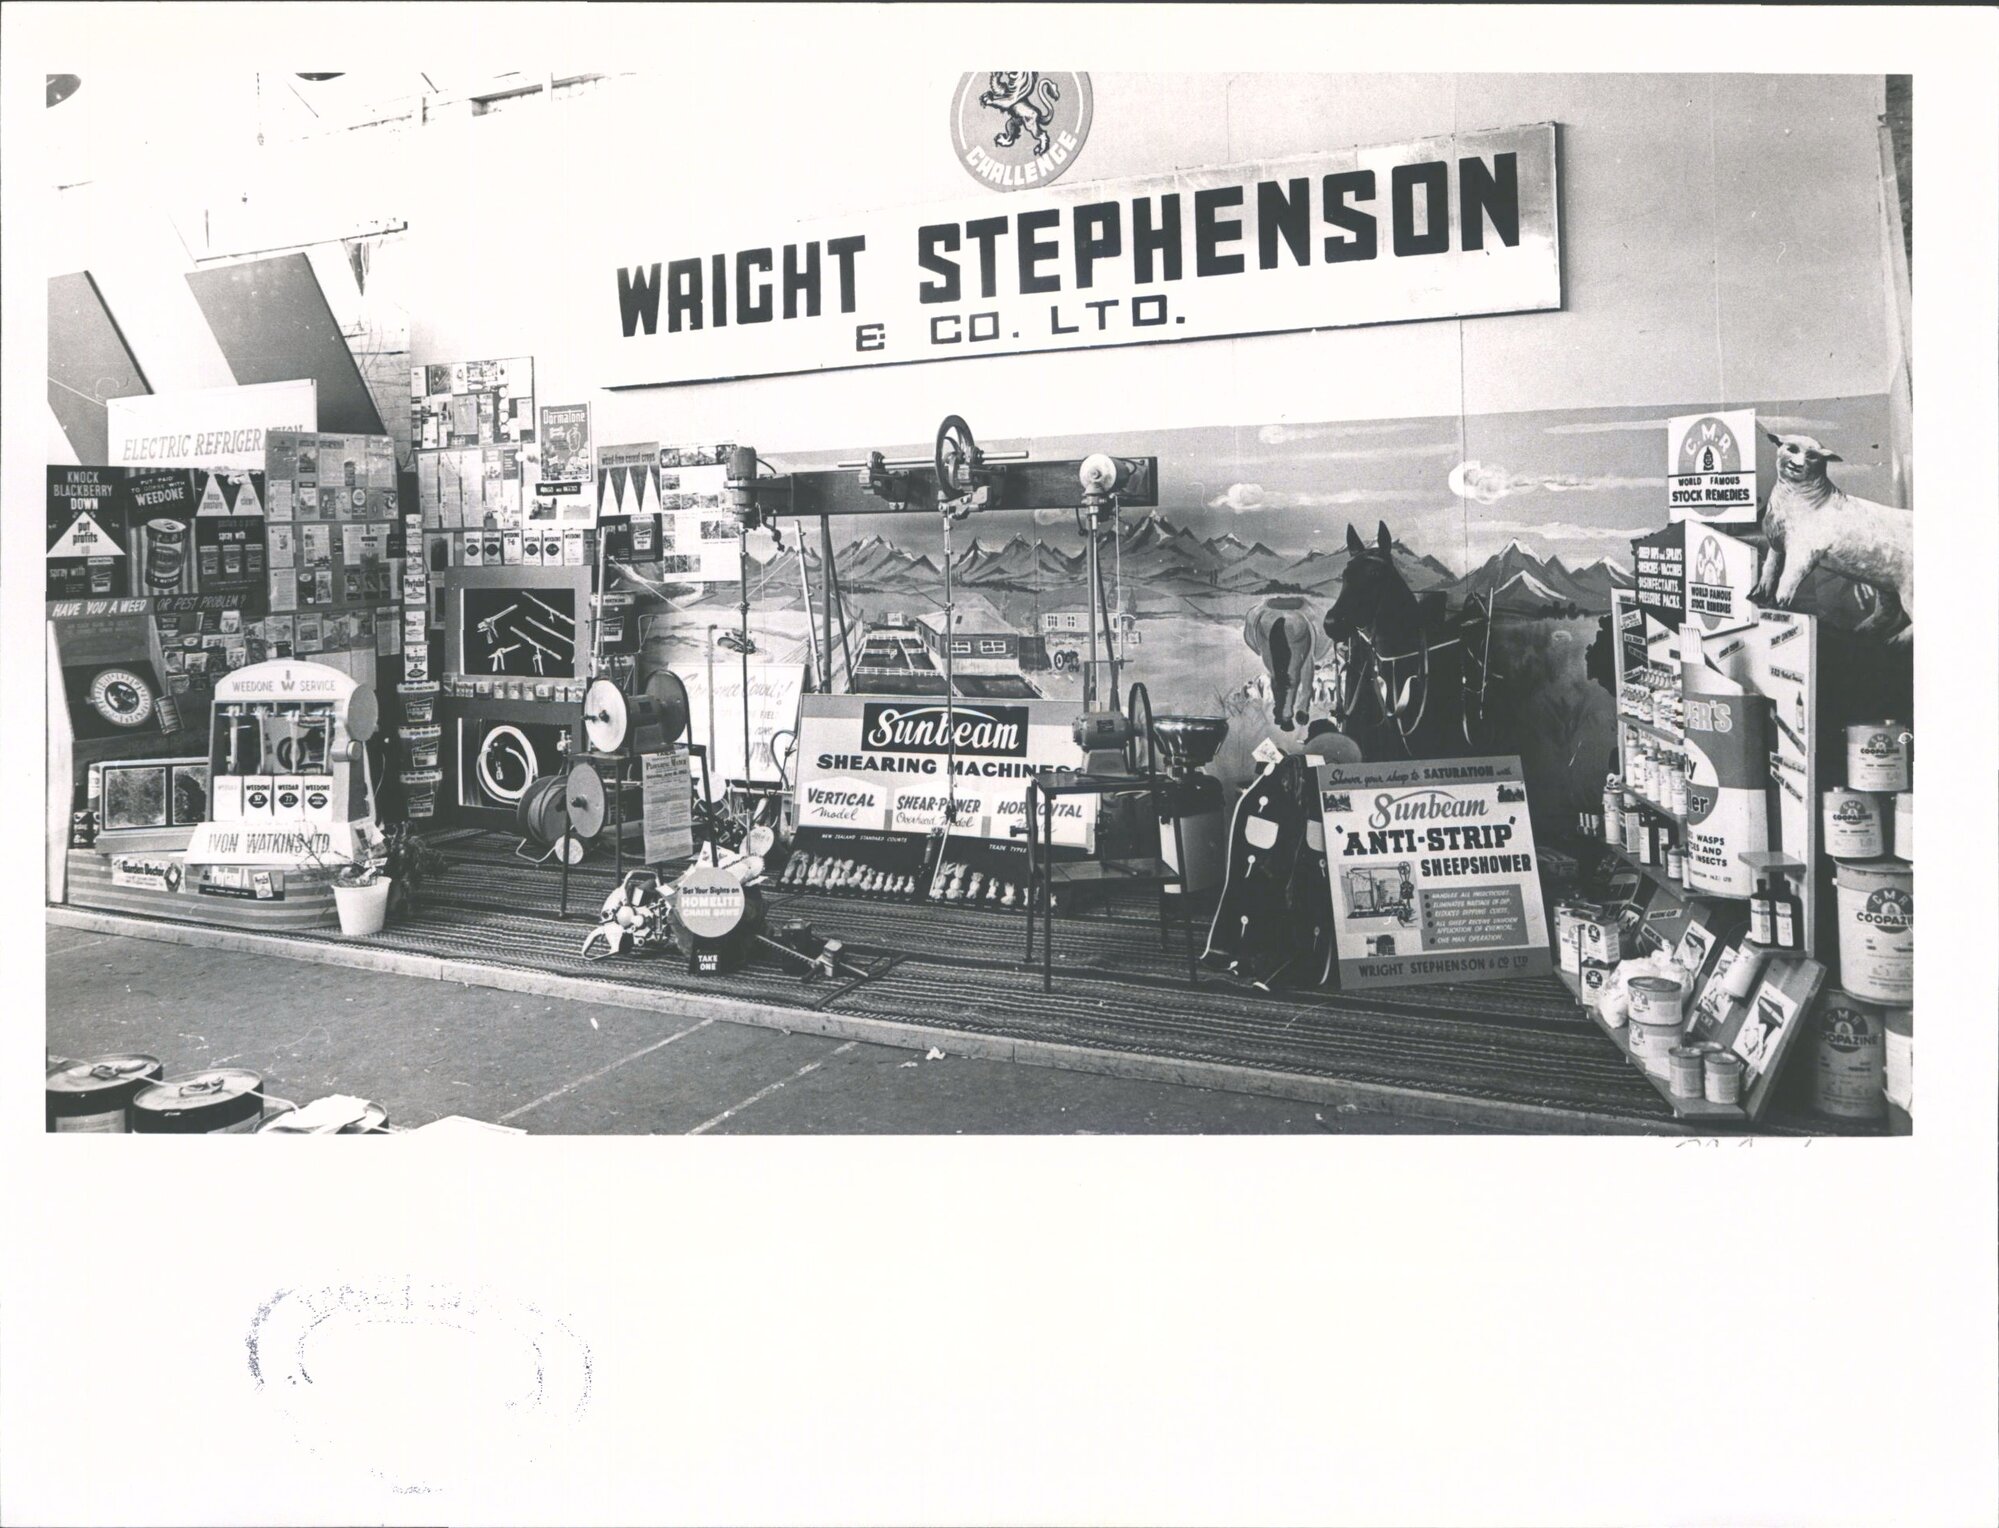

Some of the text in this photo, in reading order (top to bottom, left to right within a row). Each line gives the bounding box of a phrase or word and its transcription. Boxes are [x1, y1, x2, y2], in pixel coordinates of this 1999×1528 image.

[966, 131, 1077, 186] CHALLENGE
[617, 152, 1520, 337] WRIGHT STEPHENSON
[930, 311, 1021, 345] CO.
[1050, 294, 1187, 334] LTD.
[123, 434, 192, 461] ELECTRIC
[67, 471, 99, 484] KNOCK
[1678, 476, 1740, 486] WORLD FAMOUS
[53, 484, 112, 497] BLACKBERRY
[135, 487, 184, 506] WEEDONE
[1672, 489, 1750, 502] STOCK REMEDIES
[70, 498, 99, 510] DOWN
[78, 521, 90, 533] put
[72, 532, 98, 546] profits
[52, 599, 148, 617] HAVE YOU A WEED
[157, 598, 171, 611] OR
[173, 597, 199, 610] PEST
[232, 680, 274, 692] WEEDONE
[300, 680, 336, 692] SERVICE
[867, 707, 1020, 751] Sunbeam
[816, 753, 937, 775] SHEARING
[1364, 776, 1382, 787] your
[1411, 770, 1420, 781] to
[1423, 766, 1494, 779] SATURATION
[808, 787, 876, 807] VERTICAL
[896, 795, 981, 813] SHEAR-PWER
[811, 806, 859, 821] Model
[997, 800, 1083, 818] HORONTAL
[1369, 790, 1488, 829] Sunbeam
[209, 833, 239, 854] IVON
[247, 833, 303, 854] WATKINS
[1335, 816, 1516, 856] 'ANTI-STRIP'
[1697, 834, 1725, 846] WASPS
[1702, 846, 1722, 856] AND
[122, 860, 144, 875] Garden
[1421, 854, 1532, 877] SHEEPSHOWER
[1696, 854, 1728, 867] INSECTS
[709, 886, 730, 895] Sights
[681, 896, 741, 907] HOMELITE
[682, 908, 711, 917] CHAIN
[1358, 963, 1403, 978] WRIGHT
[1410, 958, 1486, 975] STEPHENSON
